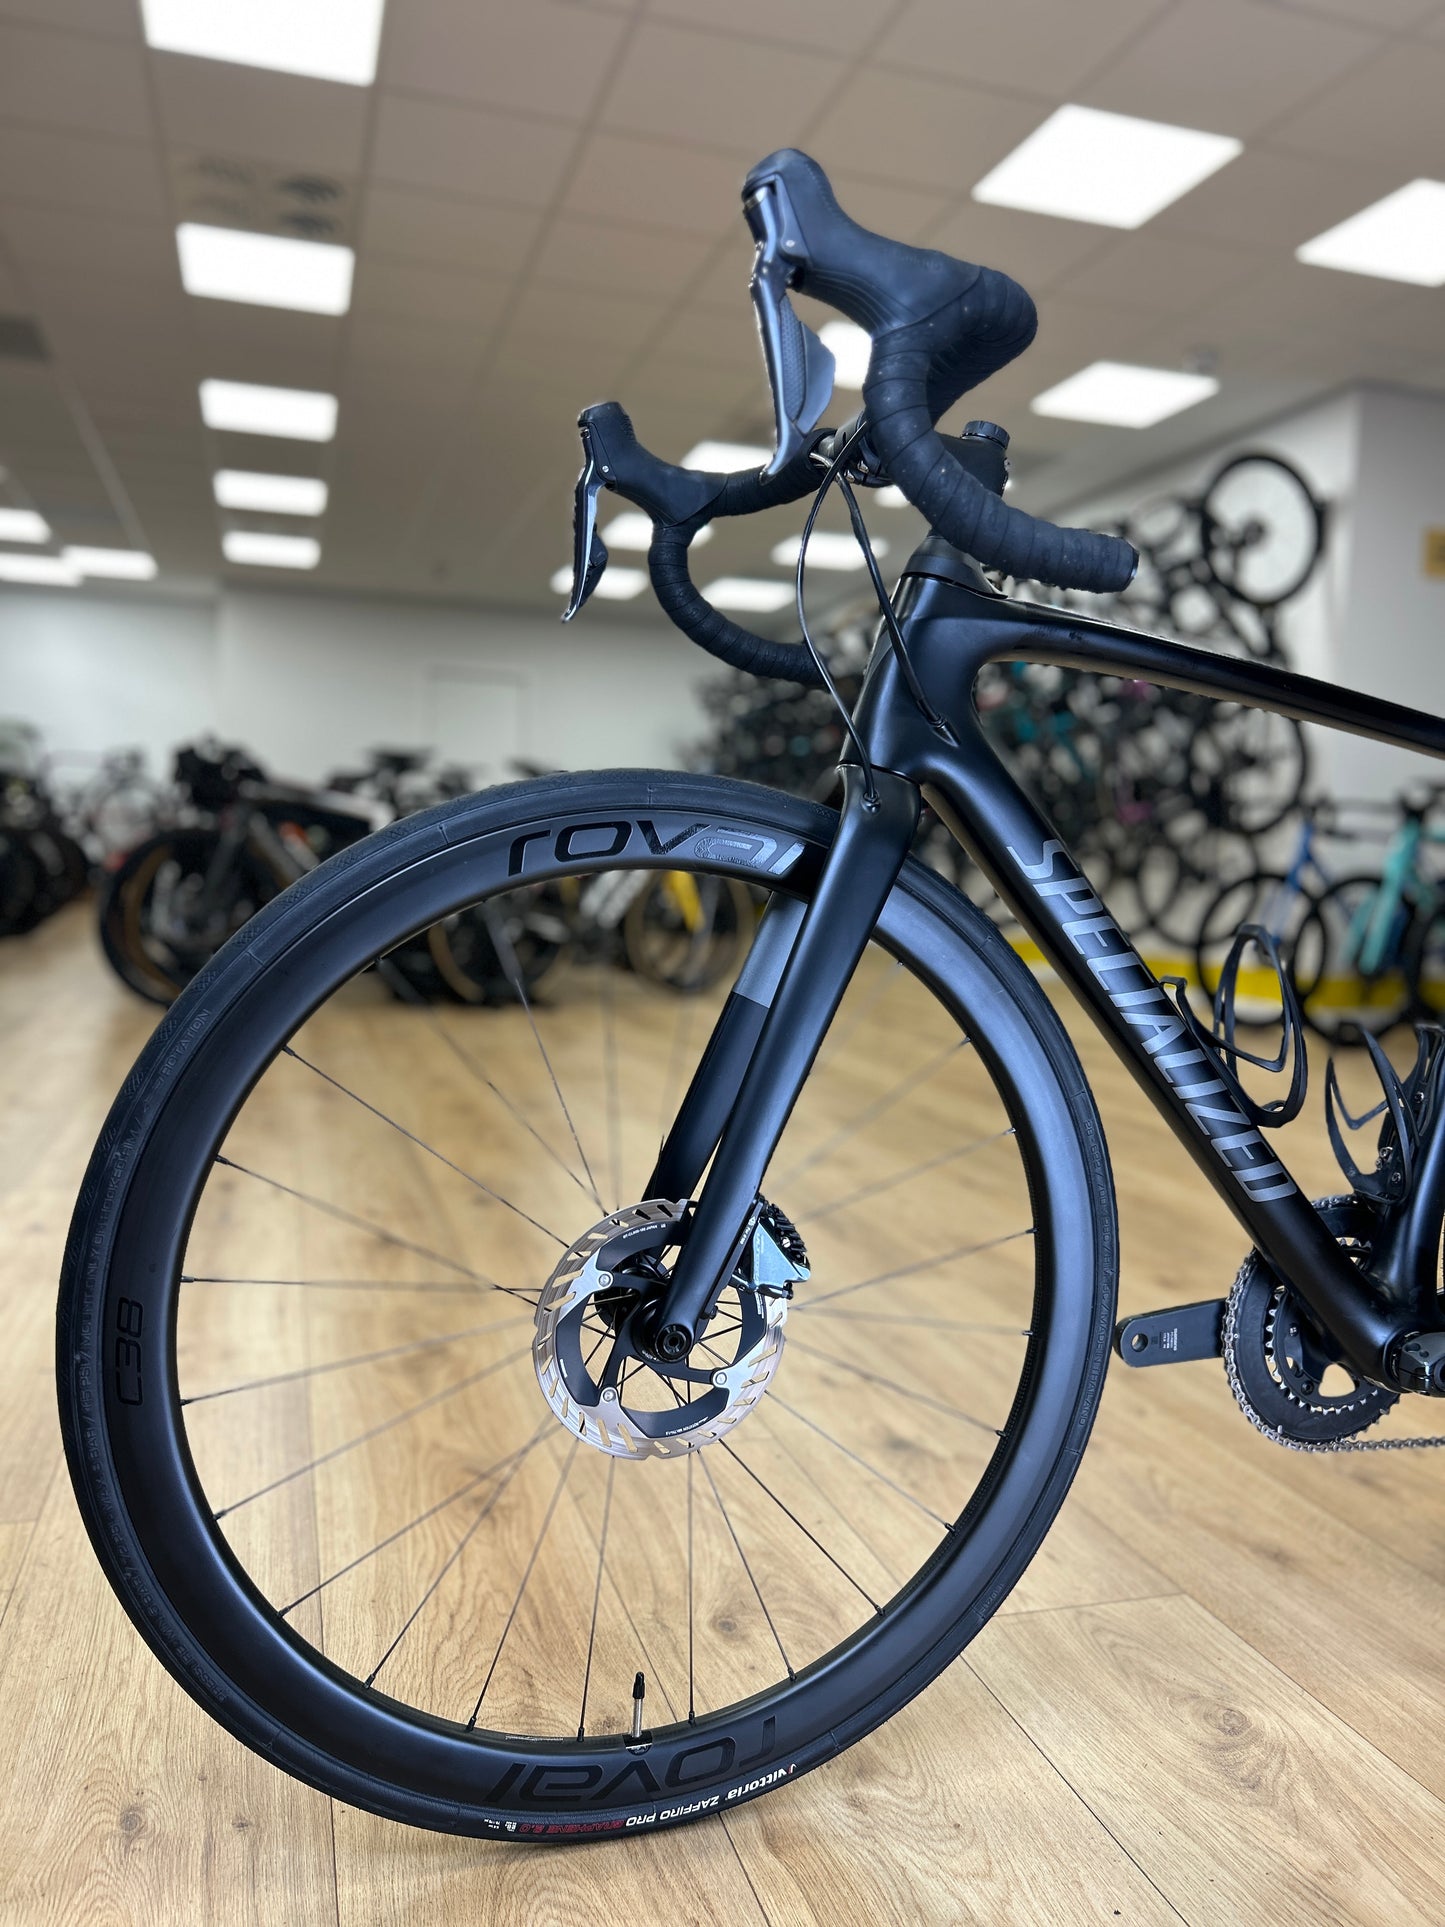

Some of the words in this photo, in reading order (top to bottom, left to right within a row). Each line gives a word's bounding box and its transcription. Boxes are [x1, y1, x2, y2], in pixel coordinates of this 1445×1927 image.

[508, 820, 807, 877] roval
[1006, 839, 1297, 1203] SPECIALIZED
[115, 1296, 144, 1407] C38
[484, 1715, 776, 1803] roval
[546, 1818, 625, 1833] GRAPHENE
[625, 1812, 657, 1827] PRO
[658, 1796, 721, 1819] ZAFFIRO
